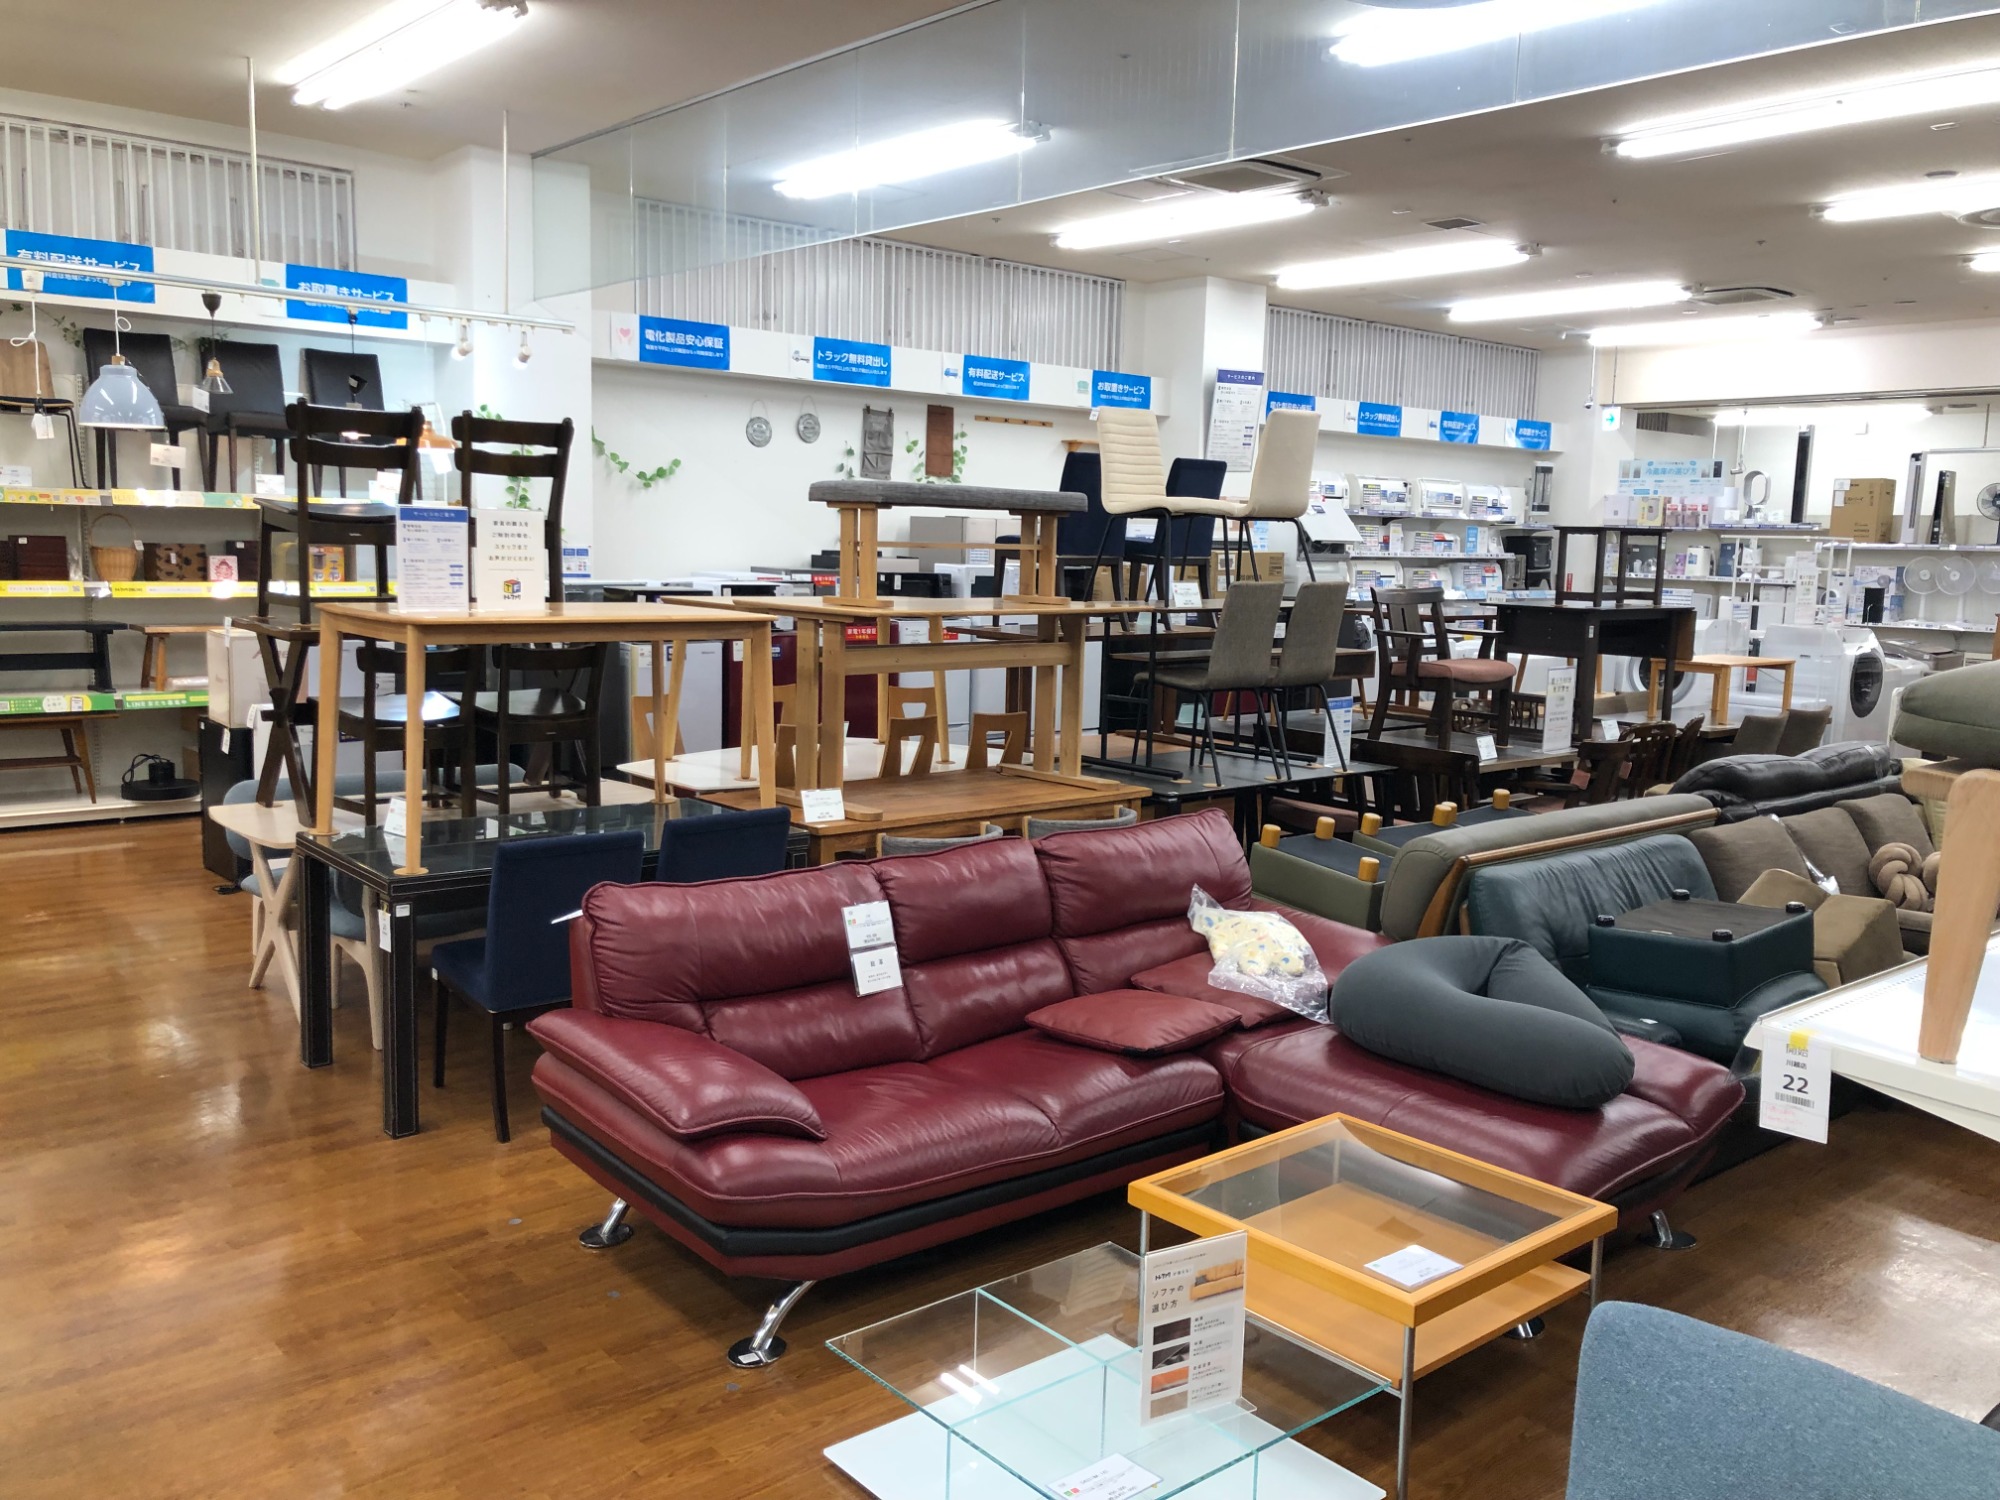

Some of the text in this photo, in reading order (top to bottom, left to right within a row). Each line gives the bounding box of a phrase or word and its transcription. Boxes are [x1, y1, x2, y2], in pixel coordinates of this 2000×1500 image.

[645, 328, 724, 350] 電化製品安心保証
[817, 349, 889, 368] トラック無料貸出し
[967, 366, 1026, 382] 有料配送サービス
[1097, 381, 1146, 395] お取置きサービス
[1782, 1073, 1809, 1094] 22
[1151, 1284, 1184, 1298] ソファの
[1151, 1299, 1178, 1314] 選び方
